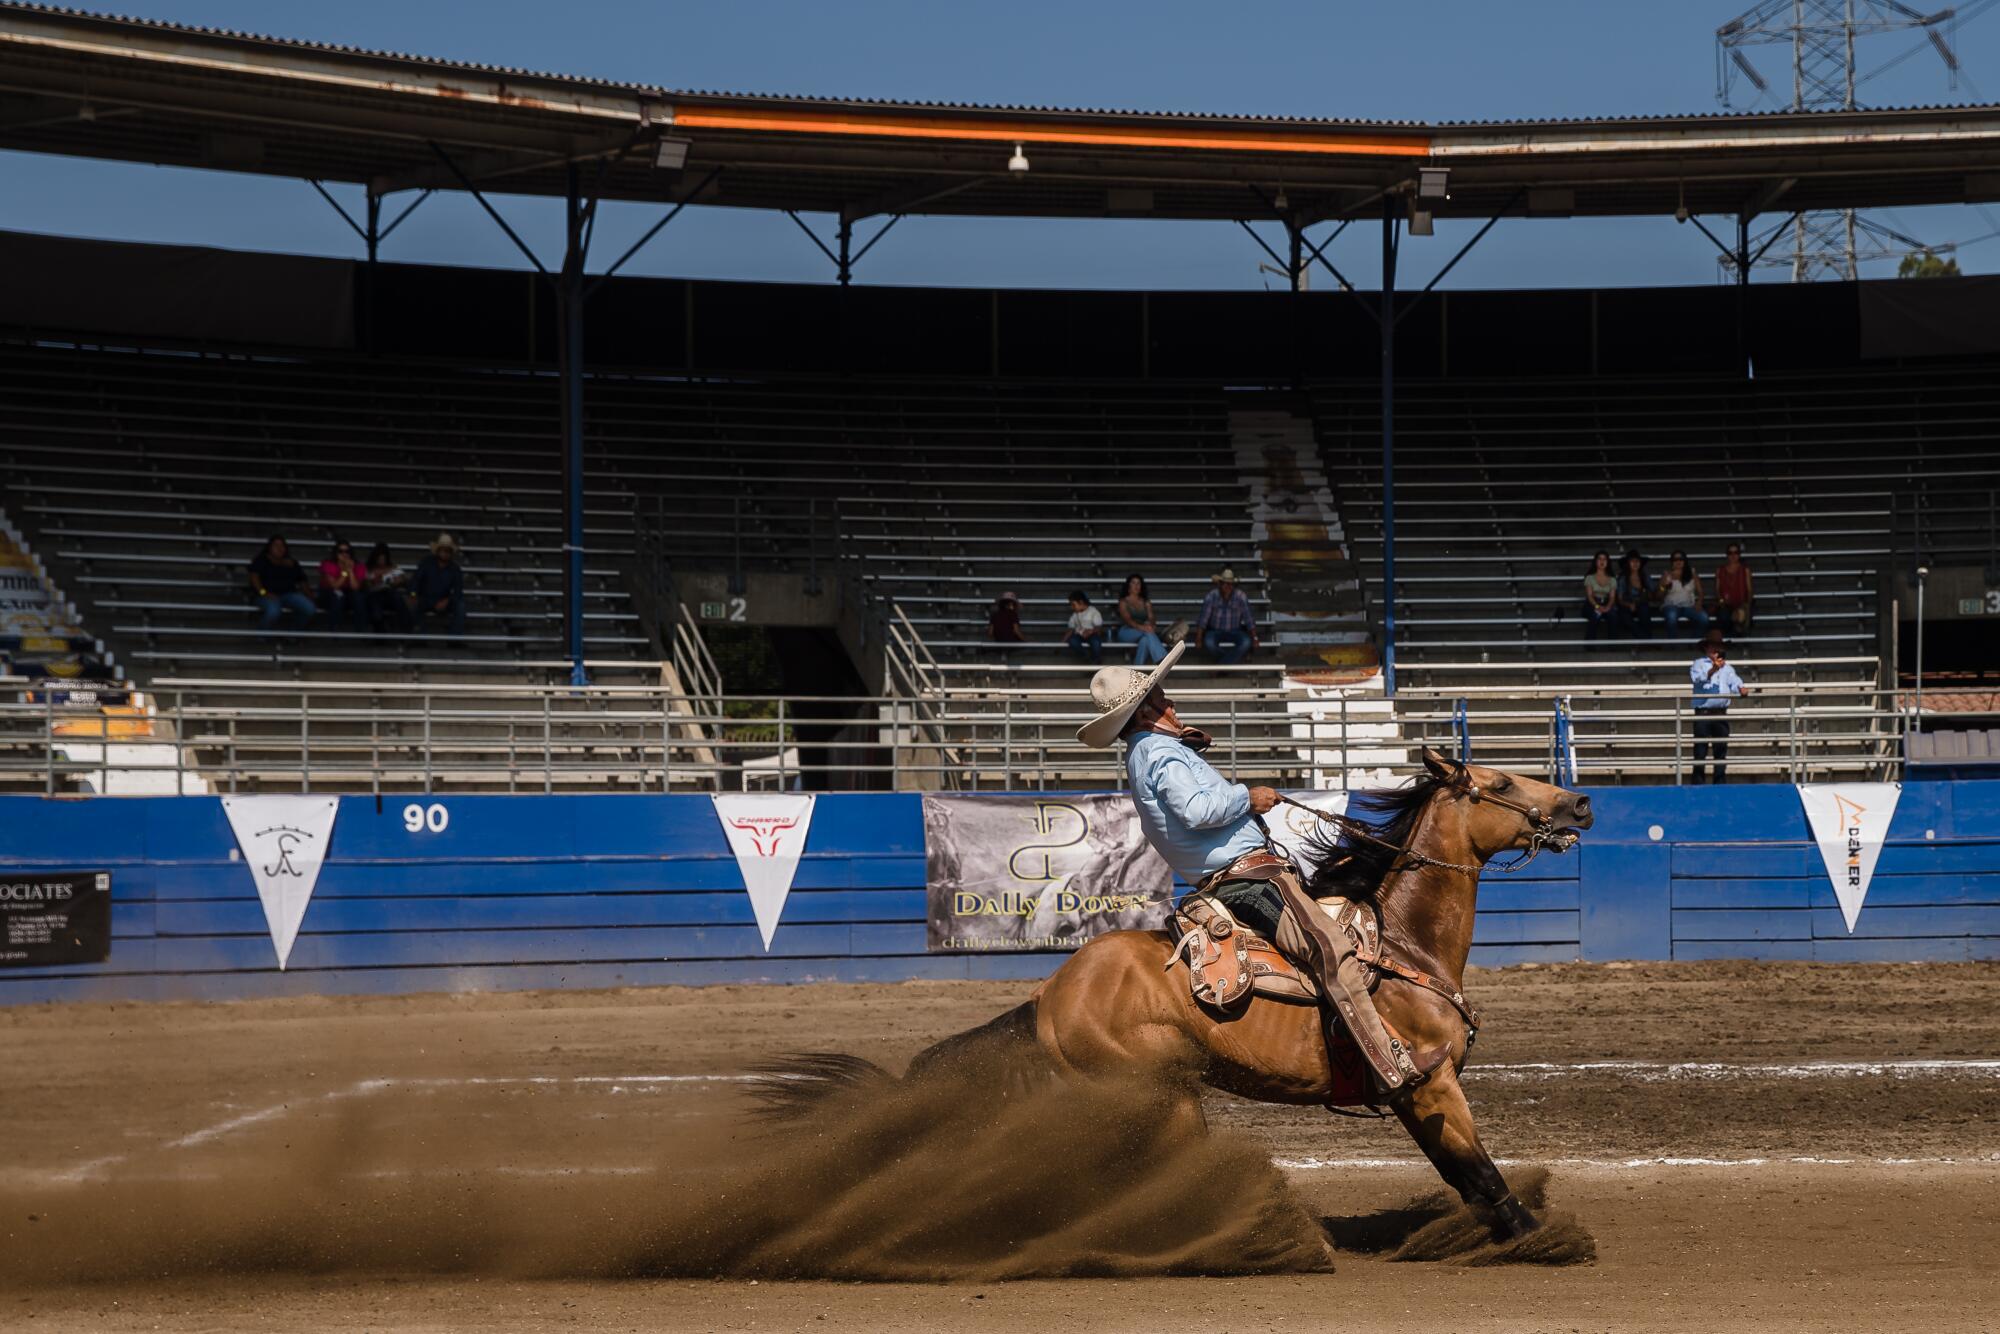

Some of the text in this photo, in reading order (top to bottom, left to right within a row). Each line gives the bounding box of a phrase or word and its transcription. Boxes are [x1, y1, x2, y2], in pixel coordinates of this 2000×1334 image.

[730, 598, 746, 621] 2
[1986, 591, 2000, 613] 3
[403, 803, 449, 832] 90
[1847, 828, 1861, 887] DENNER
[0, 883, 73, 900] OCIATES
